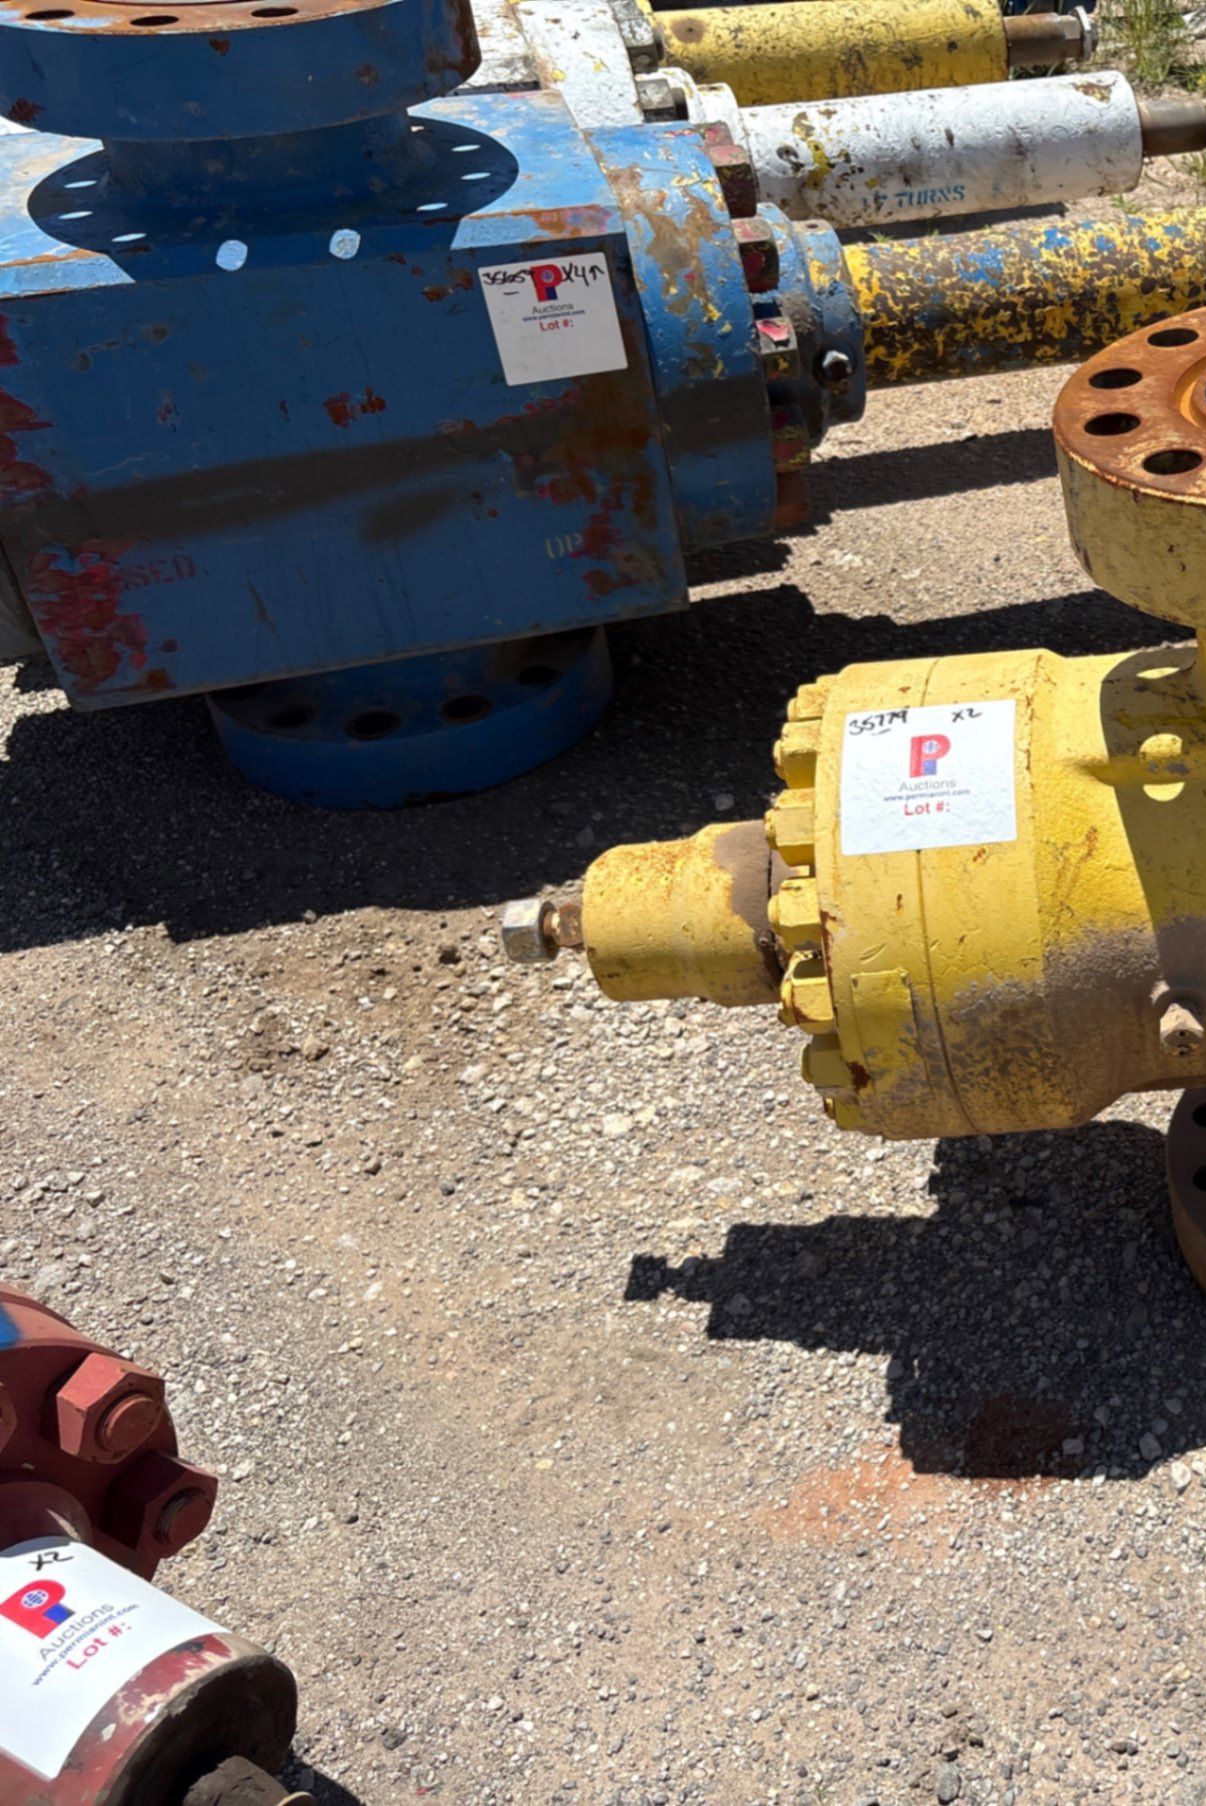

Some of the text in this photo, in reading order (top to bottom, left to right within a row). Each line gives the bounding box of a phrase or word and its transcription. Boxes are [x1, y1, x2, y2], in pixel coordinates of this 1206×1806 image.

[894, 184, 966, 208] TURNS
[532, 303, 574, 314] Auctions
[540, 318, 574, 331] Lot #:
[898, 779, 957, 792] Auctions
[904, 800, 951, 816] Lot #:
[39, 1603, 115, 1661] Auctions
[32, 1603, 140, 1686] www.permianint.com
[66, 1621, 133, 1670] Lot #:
